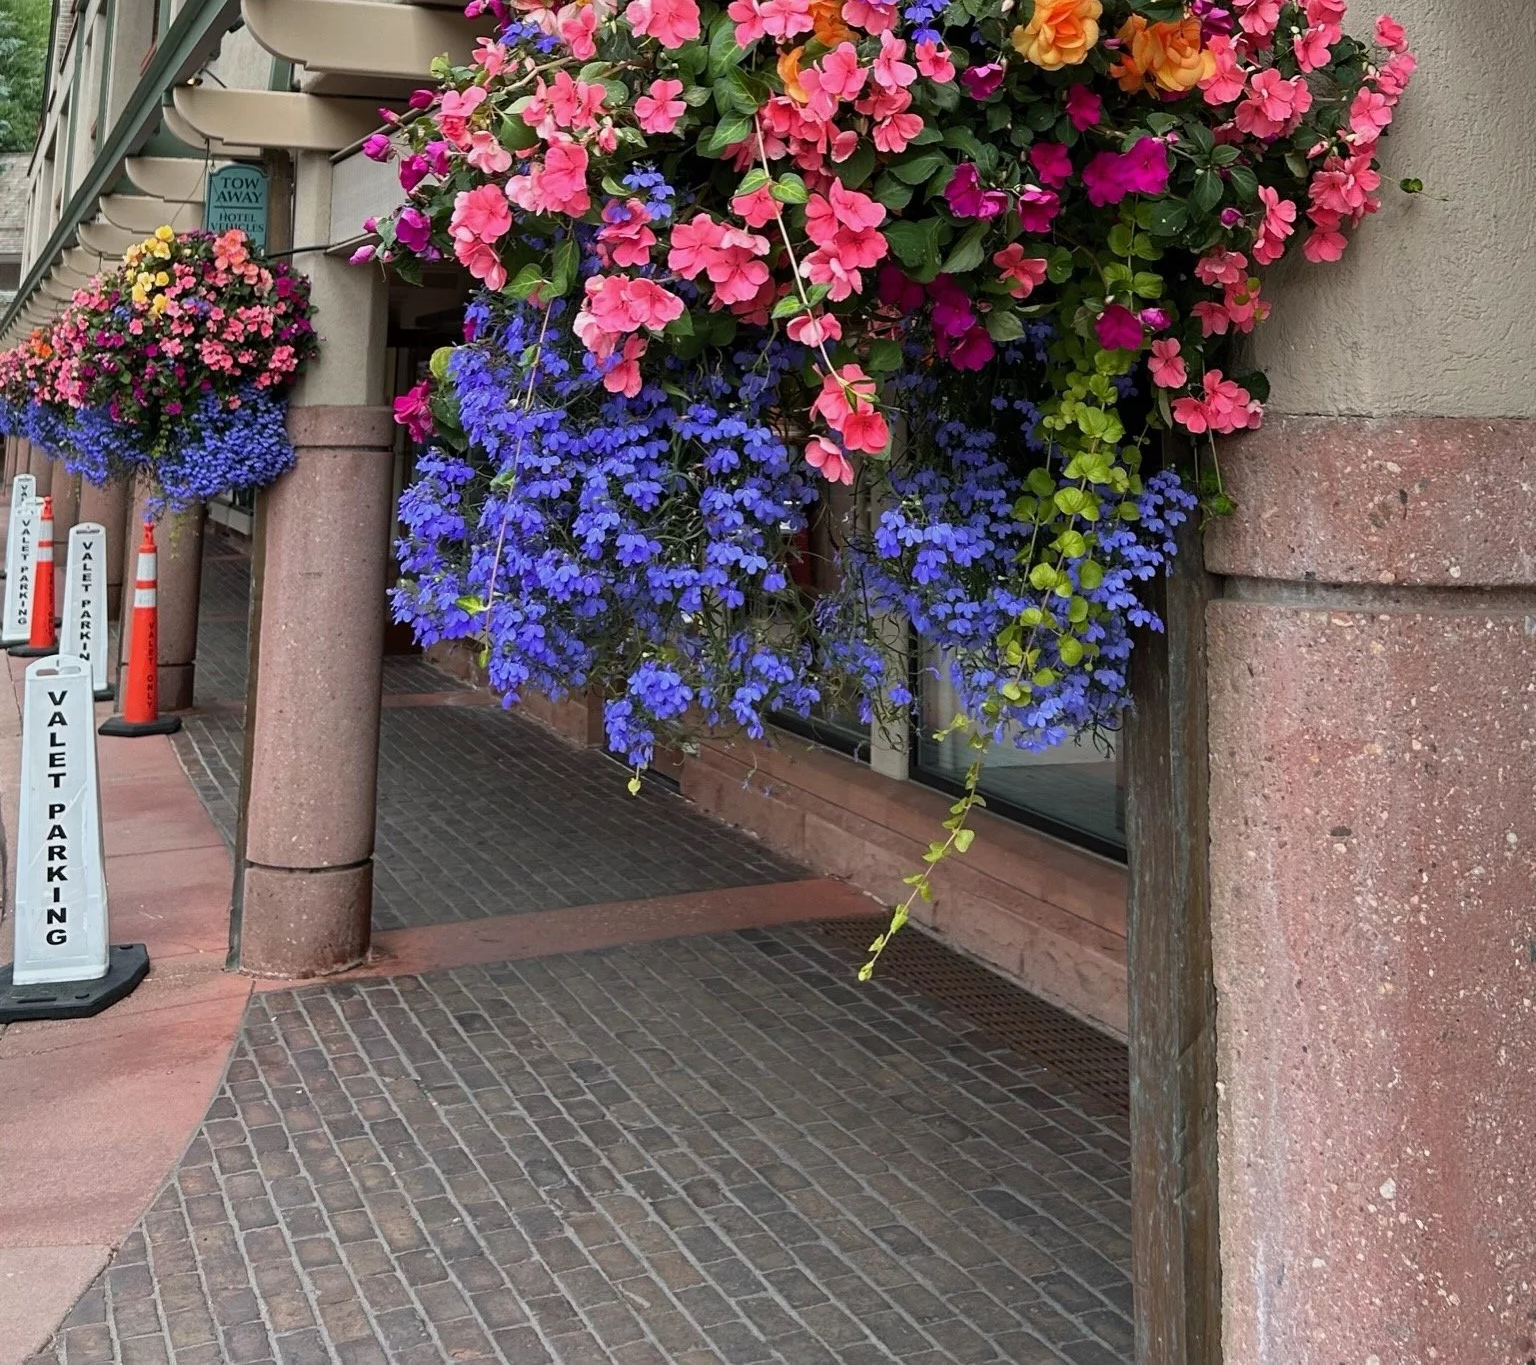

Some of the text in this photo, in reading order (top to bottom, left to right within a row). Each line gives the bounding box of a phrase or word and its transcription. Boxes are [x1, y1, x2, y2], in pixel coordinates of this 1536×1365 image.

[220, 177, 260, 189] TOW
[216, 191, 262, 203] AWAY
[219, 213, 256, 222] HOTEL
[211, 223, 264, 232] VEHICLES
[18, 519, 31, 625] VALET PARKING
[79, 541, 93, 661] VALET PARKIN
[46, 690, 68, 946] VALET PARKING
